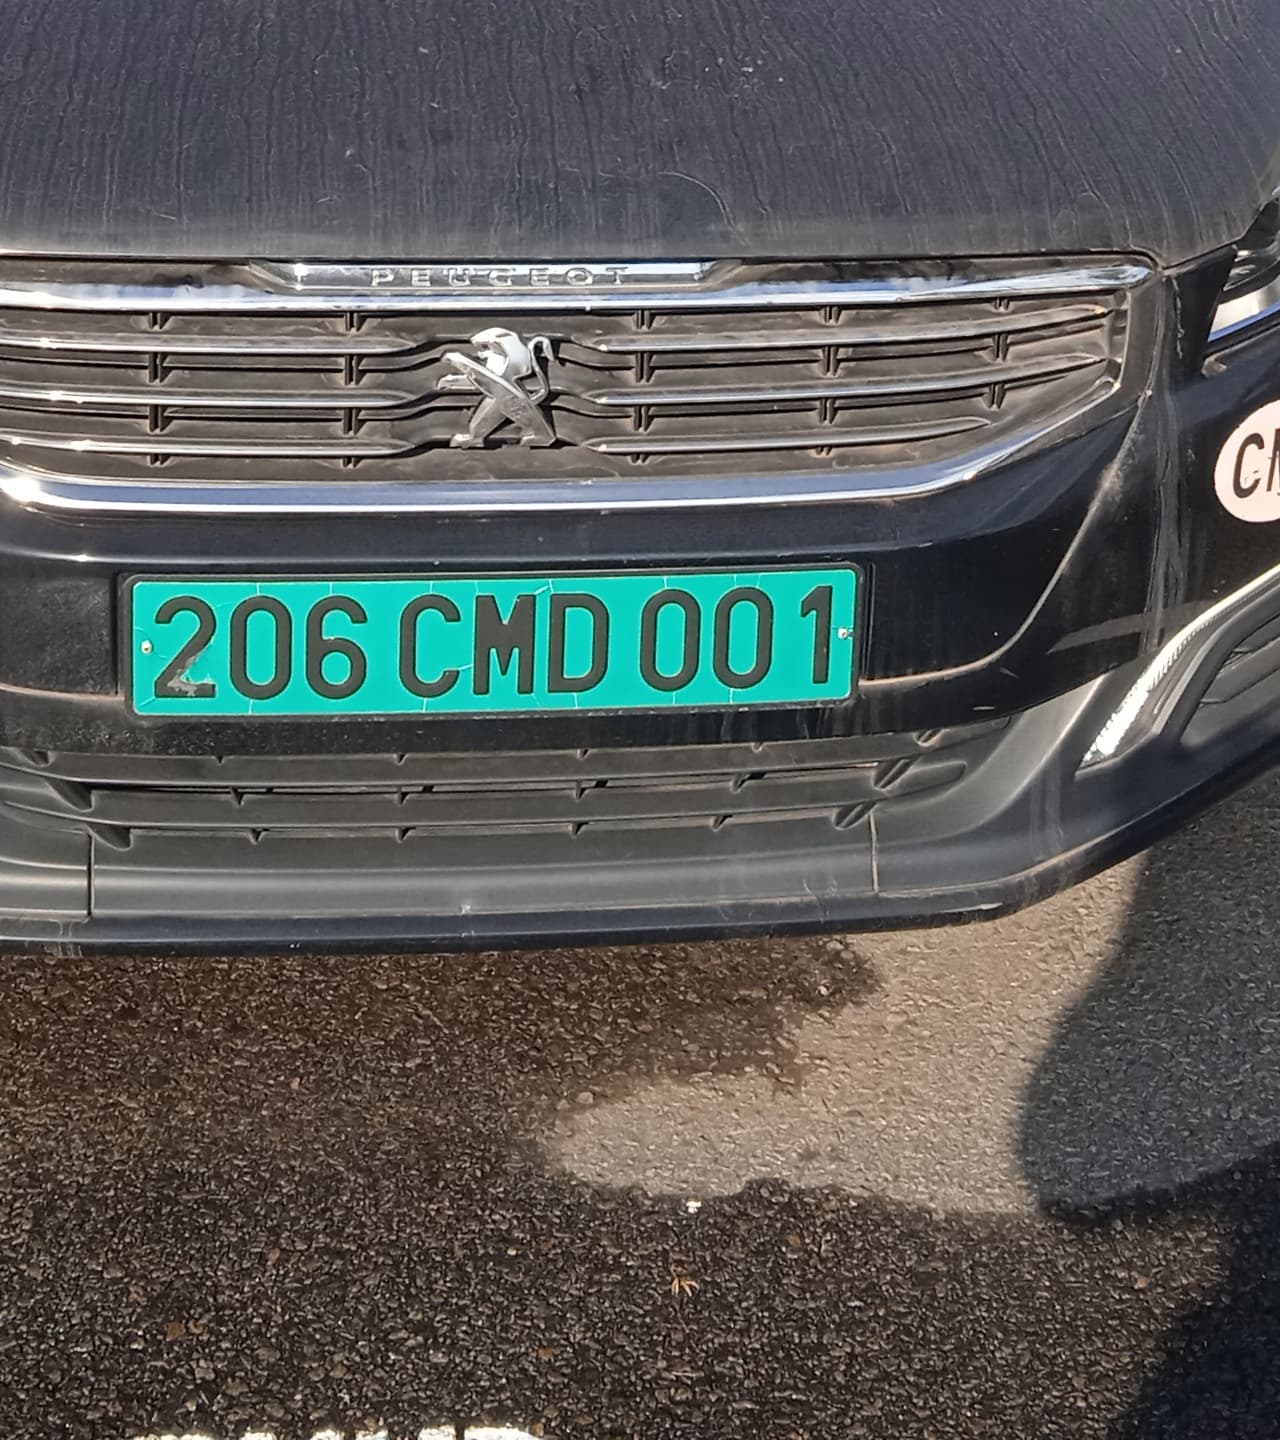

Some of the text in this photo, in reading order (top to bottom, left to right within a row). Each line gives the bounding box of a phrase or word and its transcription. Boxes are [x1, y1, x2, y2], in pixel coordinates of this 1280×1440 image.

[370, 266, 629, 287] PEUGEOT
[154, 585, 833, 700] 206 CMD 001
